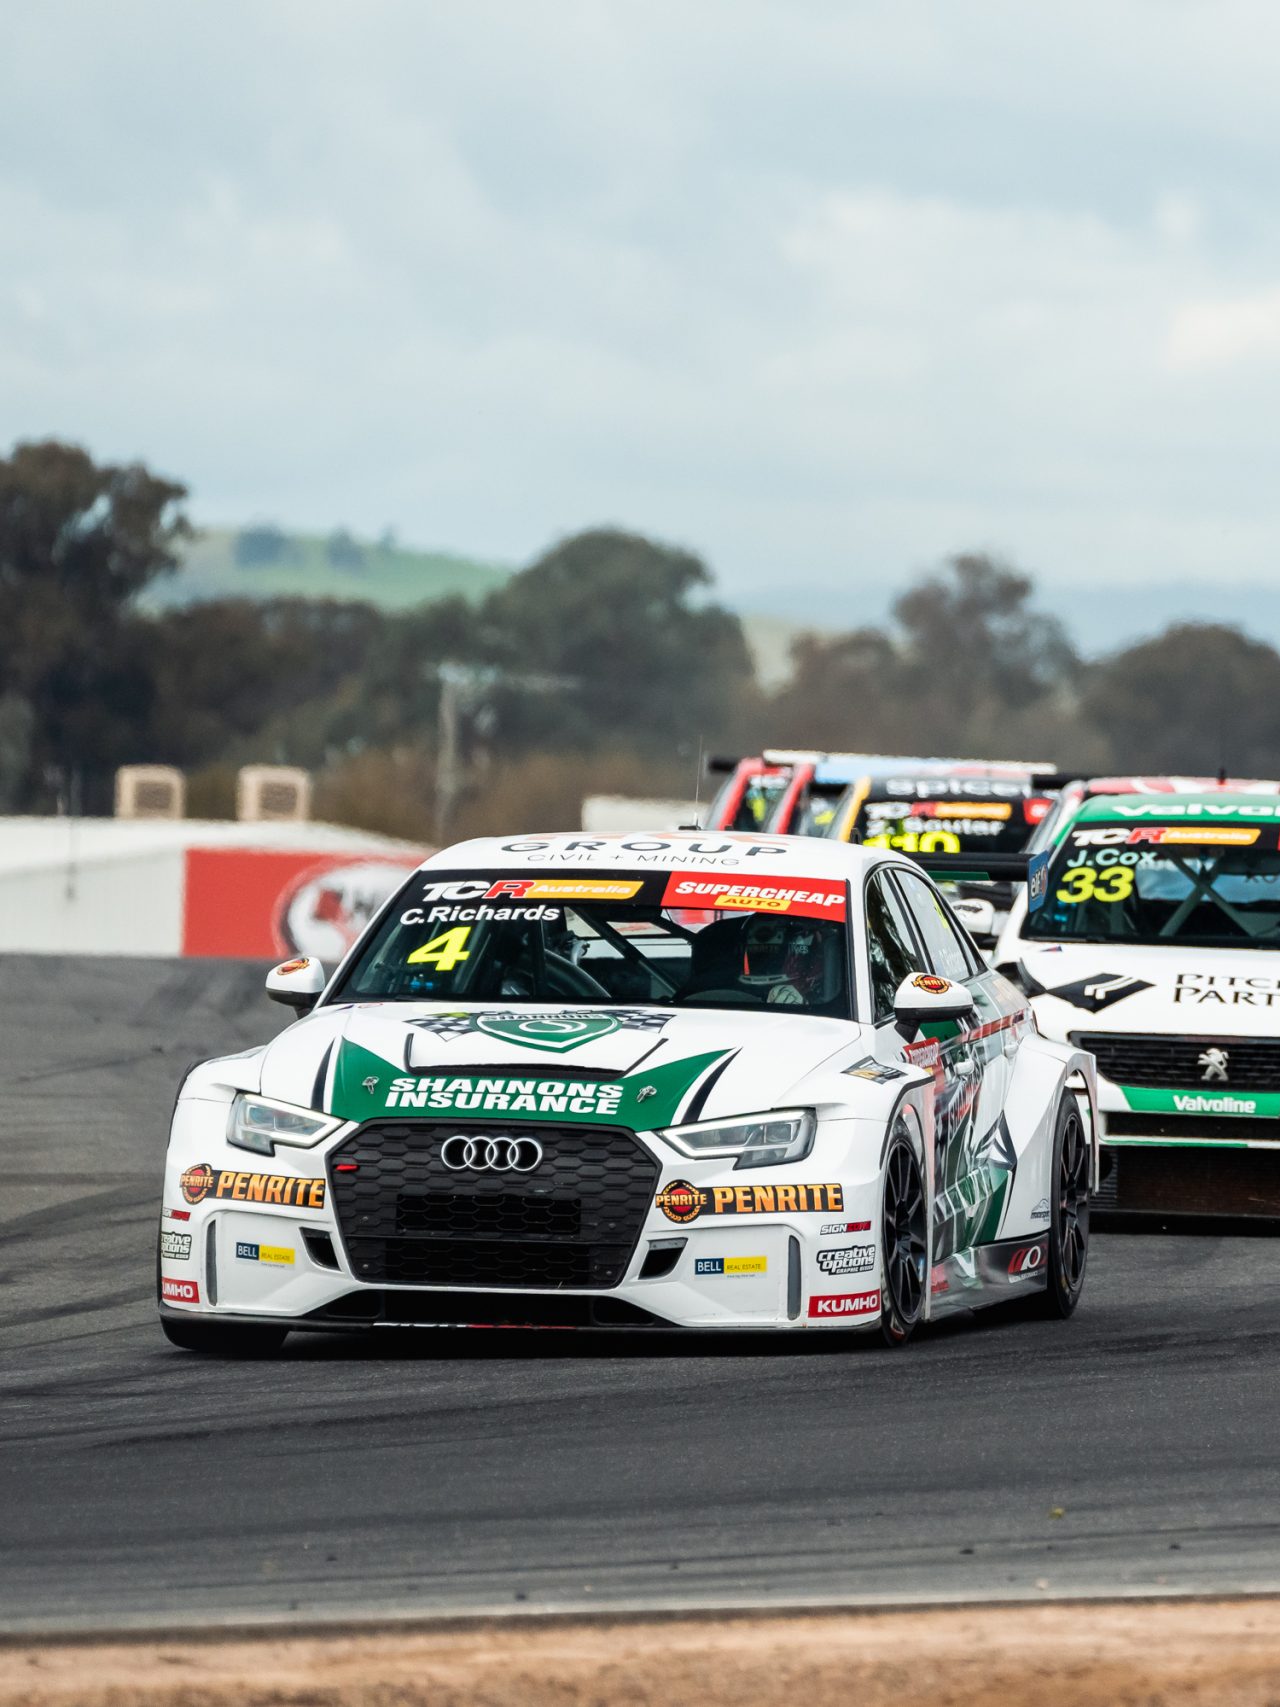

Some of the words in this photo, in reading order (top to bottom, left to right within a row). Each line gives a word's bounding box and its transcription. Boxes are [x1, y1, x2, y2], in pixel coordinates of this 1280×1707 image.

[1072, 827, 1167, 846] TCR
[501, 841, 787, 856] GROUP
[527, 854, 593, 862] CIVIL
[637, 854, 740, 866] MINING
[423, 880, 537, 902] TCR
[535, 883, 633, 895] Australia
[1056, 866, 1135, 903] 33
[675, 881, 846, 908] SUPERCHEAP
[722, 897, 782, 908] AUTO
[407, 926, 471, 971] 4
[389, 1078, 624, 1099] SHANNONS
[385, 1091, 620, 1115] INSURANCE
[1173, 1095, 1256, 1114] Valvoline
[181, 1174, 214, 1187] PENRITE
[216, 1171, 326, 1207] PENRITE
[655, 1194, 708, 1206] PENRITE
[712, 1183, 843, 1213] PENRITE
[161, 1233, 191, 1245] reative
[237, 1244, 258, 1258] BELL
[818, 1246, 875, 1262] creative
[697, 1260, 722, 1272] BELL
[822, 1256, 874, 1273] options
[162, 1283, 194, 1299] UMHO
[817, 1294, 878, 1314] KUMHO
